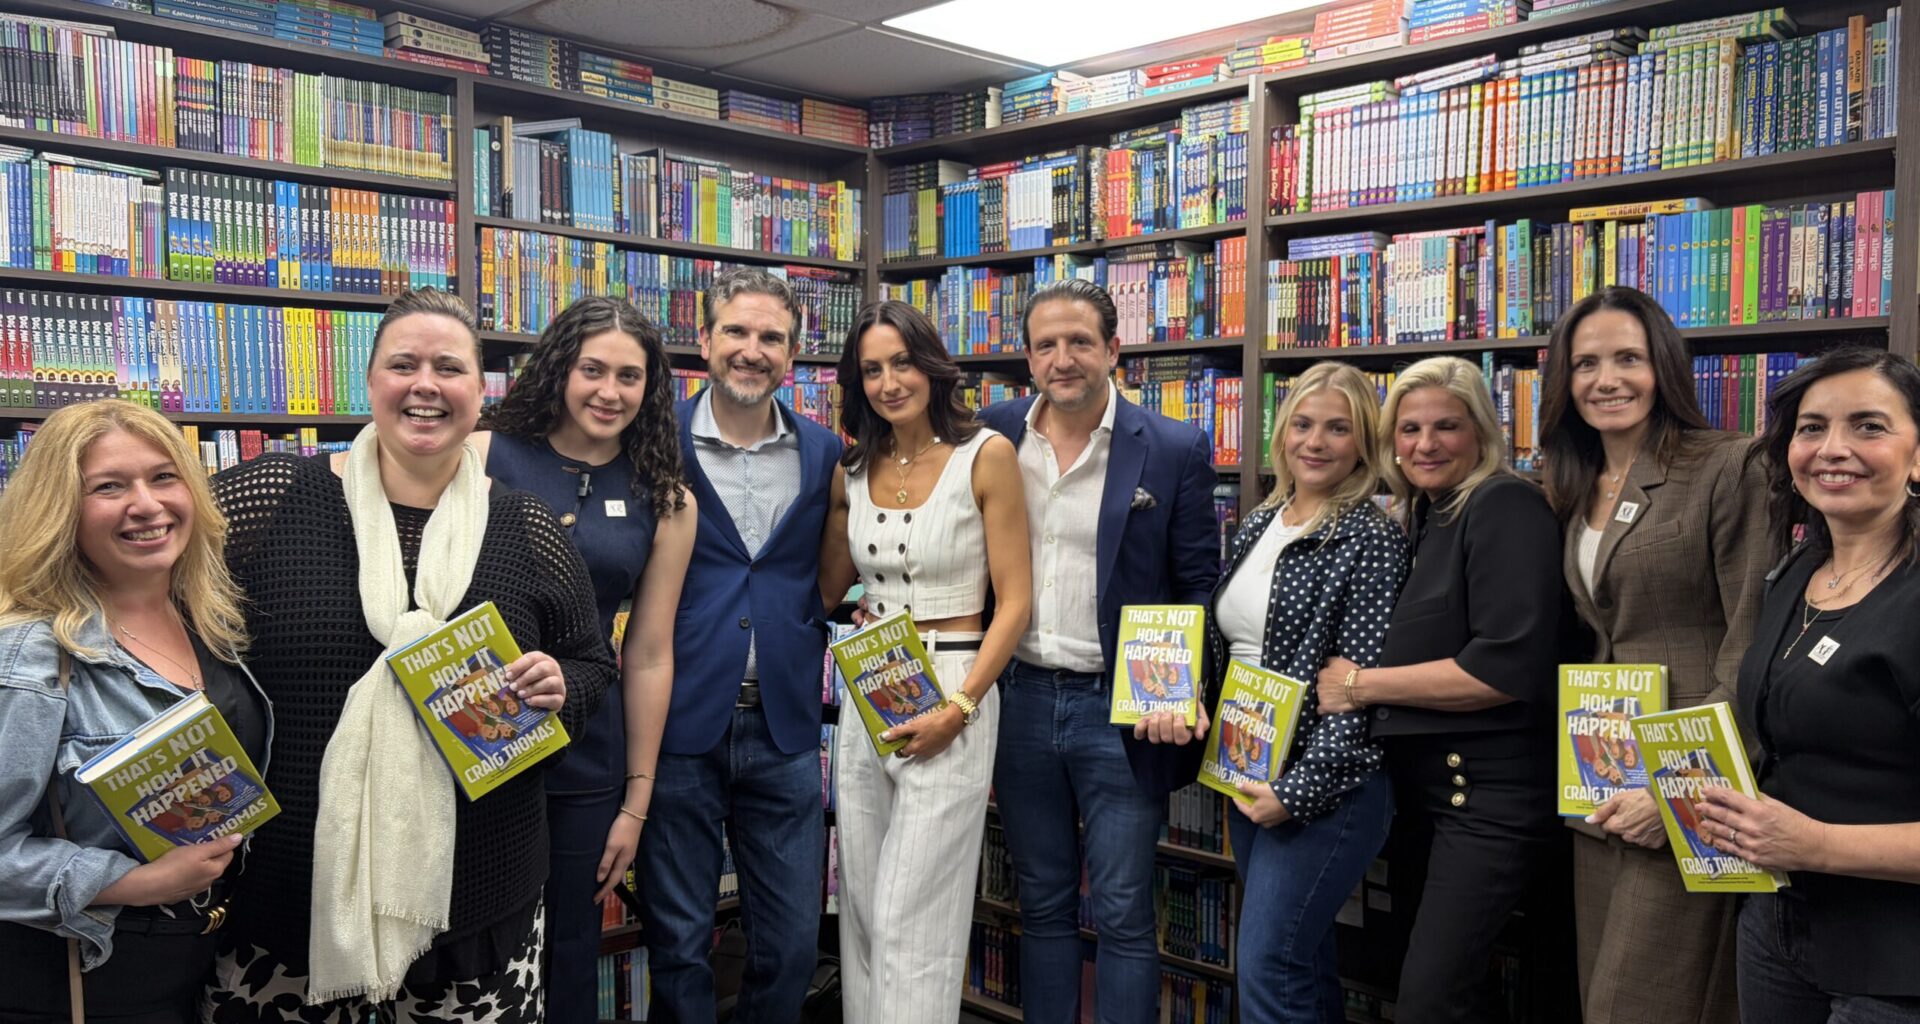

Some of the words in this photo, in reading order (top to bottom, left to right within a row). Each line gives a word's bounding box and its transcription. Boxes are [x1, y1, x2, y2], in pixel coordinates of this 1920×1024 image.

[1835, 69, 1843, 85] OUT
[1819, 100, 1827, 118] LEFT
[1819, 120, 1827, 139] FIELD
[1857, 239, 1866, 271] allergic
[1870, 238, 1879, 271] allergic
[1883, 237, 1893, 280] SQUISHED
[7, 315, 15, 328] DOG
[19, 316, 28, 328] DOG
[32, 317, 40, 329] DOG
[1128, 610, 1163, 624] THAT'S
[1166, 609, 1197, 627] NOT
[401, 638, 455, 674] THAT'S
[452, 614, 496, 650] NOT
[840, 635, 878, 660] THAT'S
[878, 621, 909, 645] NOT
[1136, 628, 1166, 642] HOW
[1171, 630, 1184, 644] IT
[859, 652, 888, 672] HOW
[892, 644, 906, 659] IT
[1124, 645, 1192, 664] HAPPENED
[429, 657, 471, 689] HOW
[475, 647, 493, 668] IT
[856, 658, 924, 696] HAPPENED
[1567, 670, 1612, 688] THAT'S
[1616, 670, 1653, 692] NOT
[429, 665, 511, 721] HAPPENE
[1231, 665, 1262, 690] THAT'S
[1262, 677, 1291, 704] NOT
[1116, 700, 1146, 712] CRAIG
[1148, 701, 1190, 713] THOMAS
[1233, 688, 1259, 710] HOW
[1261, 702, 1275, 720] IT
[1580, 693, 1614, 712] HOW
[1623, 696, 1638, 714] IT
[1220, 703, 1277, 744] HAPPENED
[1567, 716, 1635, 740] HAPPEN
[1638, 723, 1678, 743] THAT'S
[1678, 717, 1714, 743] NOT
[104, 748, 168, 792] THAT'S
[168, 715, 216, 757] NOT
[464, 753, 503, 784] CRAIG
[501, 721, 556, 761] THOMAS
[1658, 749, 1690, 769] HOW
[1697, 749, 1710, 769] IT
[135, 763, 184, 798] HOW
[191, 748, 210, 768] IT
[1203, 760, 1228, 778] CRAIG
[1228, 770, 1258, 785] THO
[131, 755, 237, 826] HAPPENED
[1564, 785, 1600, 800] CRAIG
[207, 798, 268, 841] THOMAS
[1681, 858, 1713, 874] CRAIG
